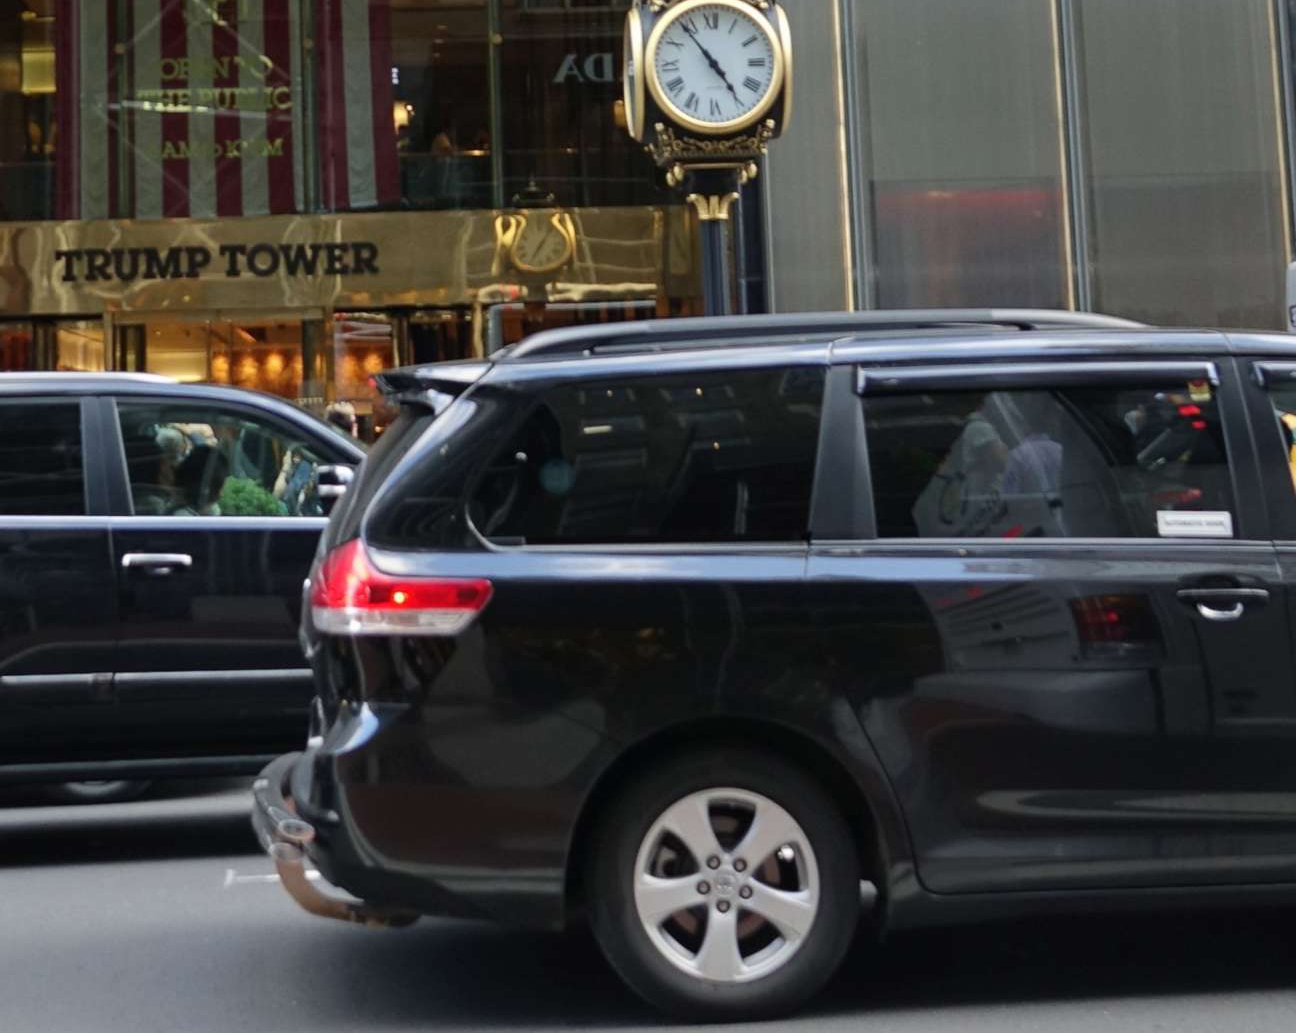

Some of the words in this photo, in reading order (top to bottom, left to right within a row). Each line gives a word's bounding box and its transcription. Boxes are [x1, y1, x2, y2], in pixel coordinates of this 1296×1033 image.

[160, 56, 230, 80] OPN
[55, 243, 212, 283] TRUMP
[218, 241, 380, 278] TOWER
